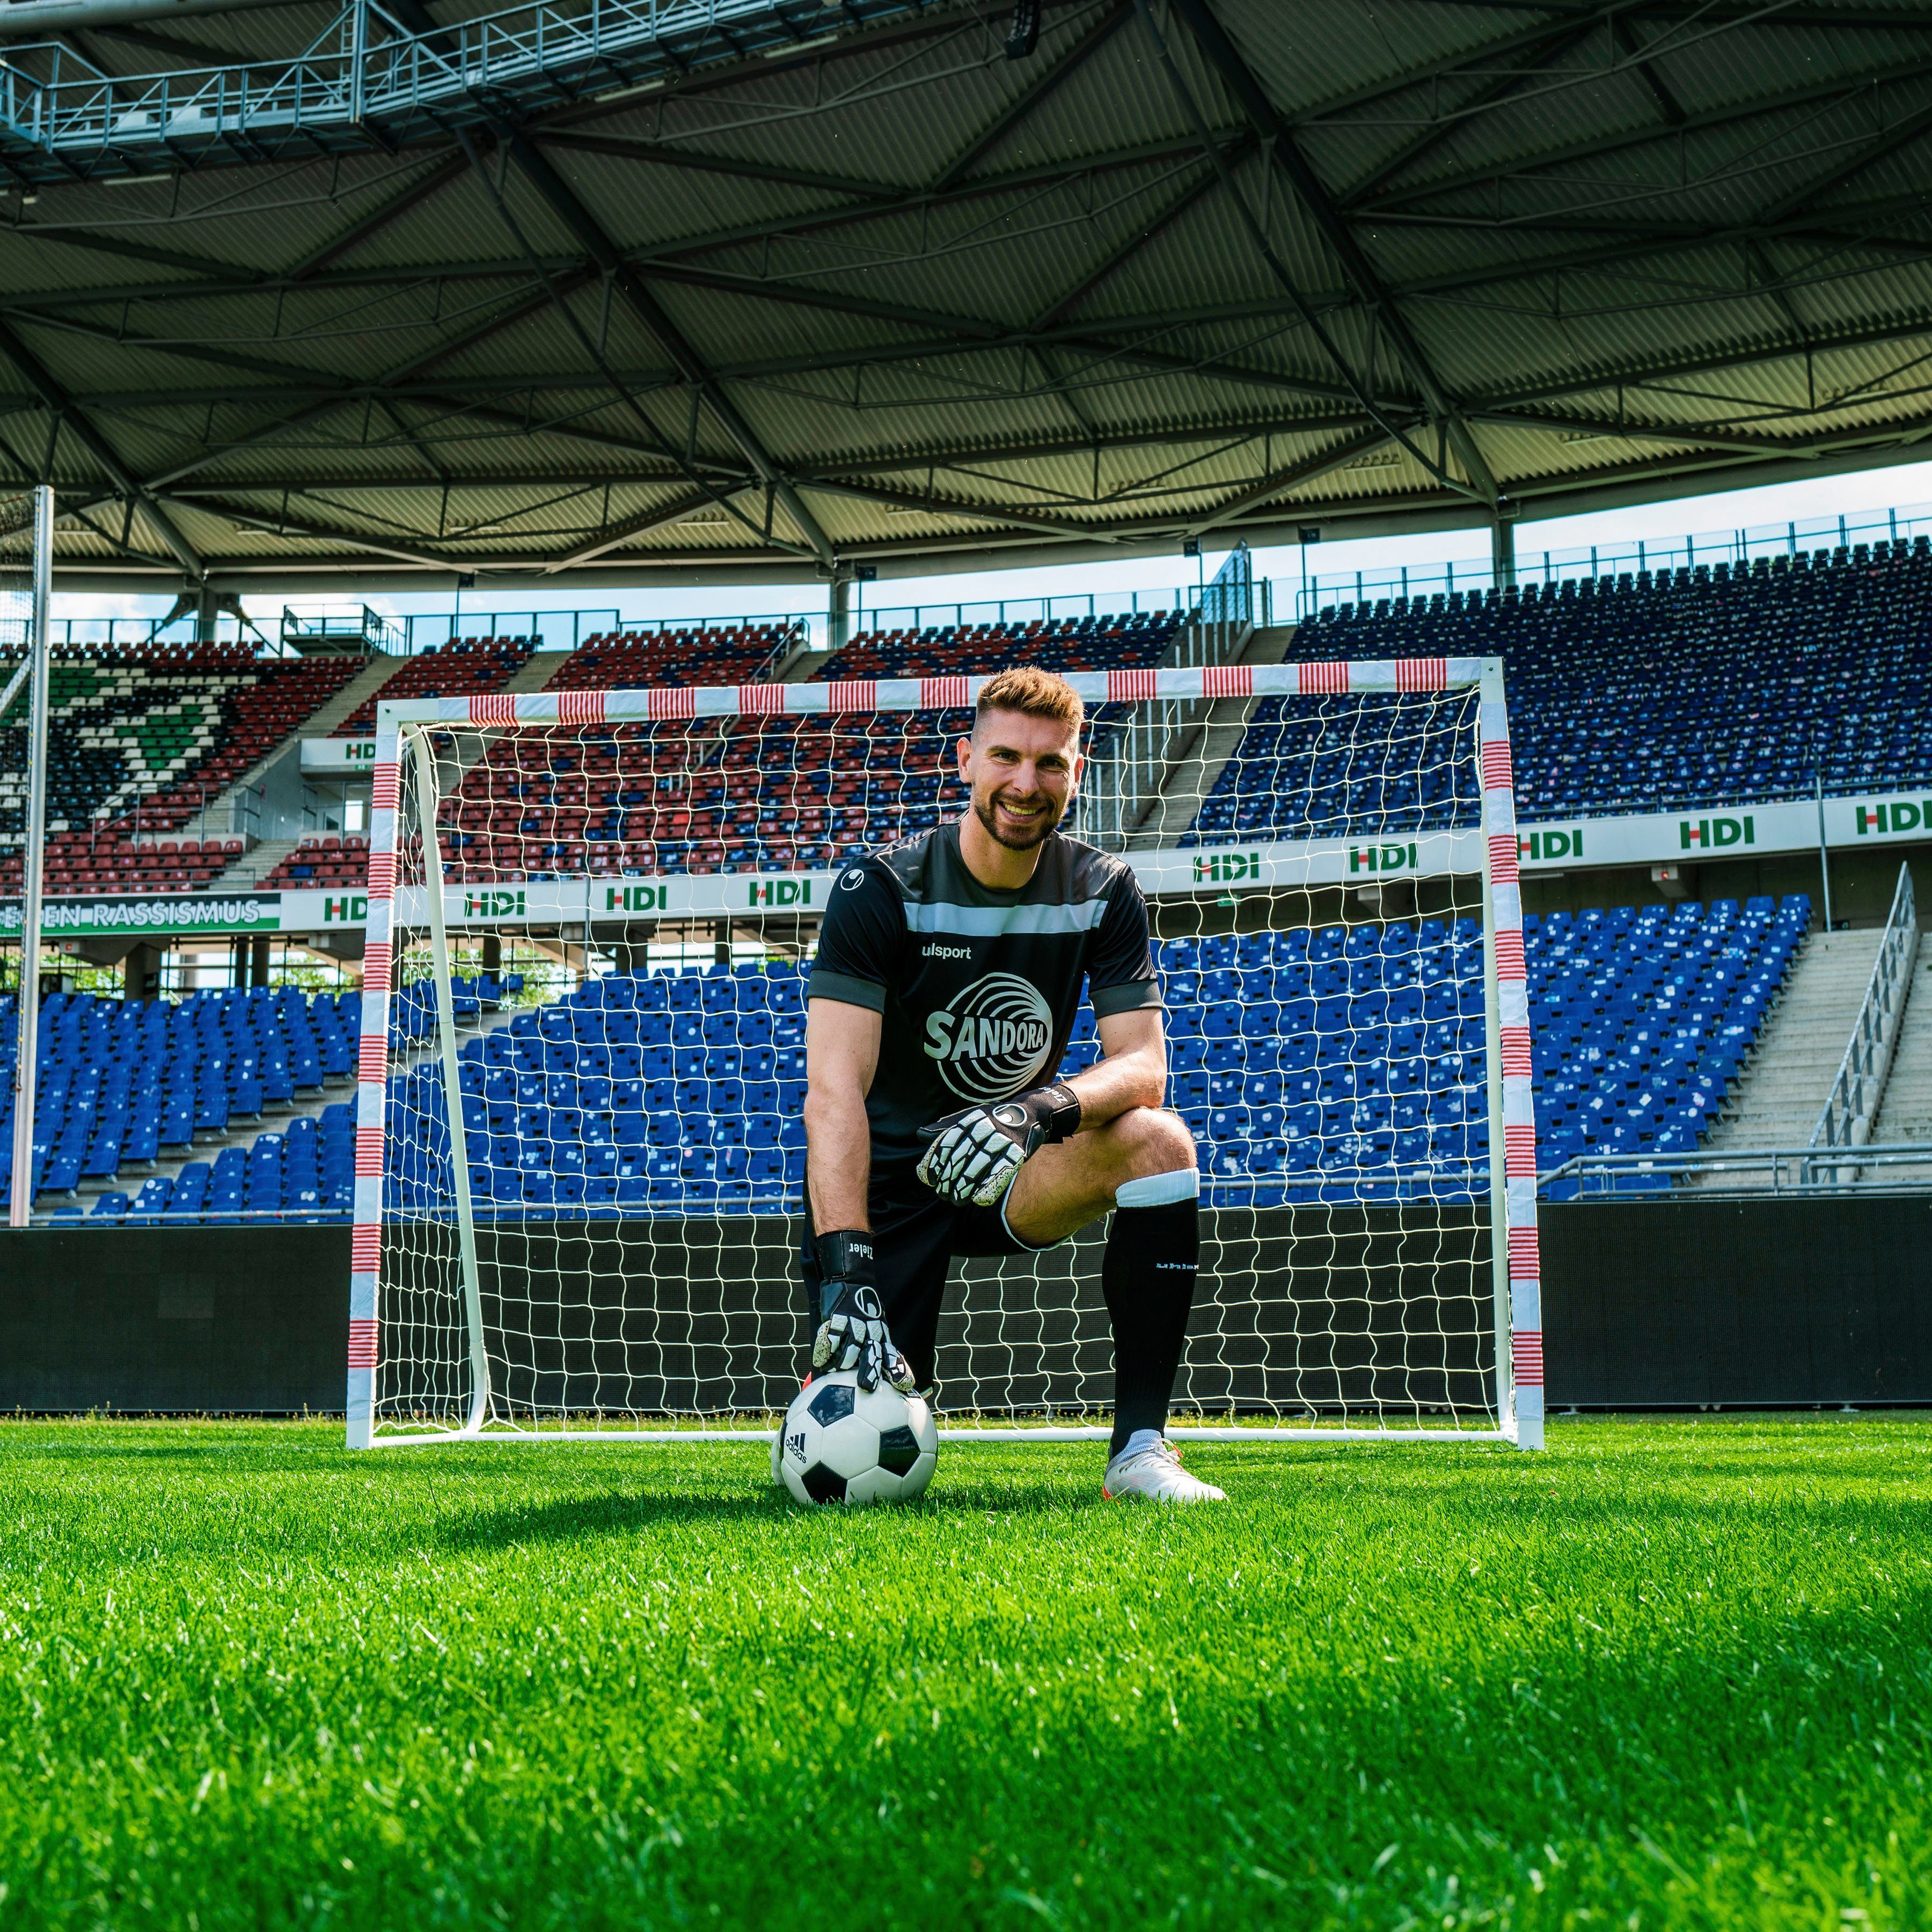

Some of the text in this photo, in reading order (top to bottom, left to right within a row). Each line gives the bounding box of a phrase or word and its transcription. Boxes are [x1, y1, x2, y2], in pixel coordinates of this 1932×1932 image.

[346, 744, 376, 759] HD
[1856, 801, 1932, 835] HDI
[1517, 830, 1583, 860] HDI
[1680, 816, 1755, 849] HDI
[1193, 853, 1259, 882] HDI
[1349, 843, 1418, 872] HDI
[464, 891, 525, 917] HDI
[606, 885, 667, 912] HDI
[749, 880, 811, 906] HDI
[93, 899, 260, 927] RASSISMUS
[325, 897, 368, 921] HD
[924, 1011, 1043, 1061] SANDORA
[849, 1243, 873, 1260] Zieler
[786, 1439, 807, 1463] adidas
